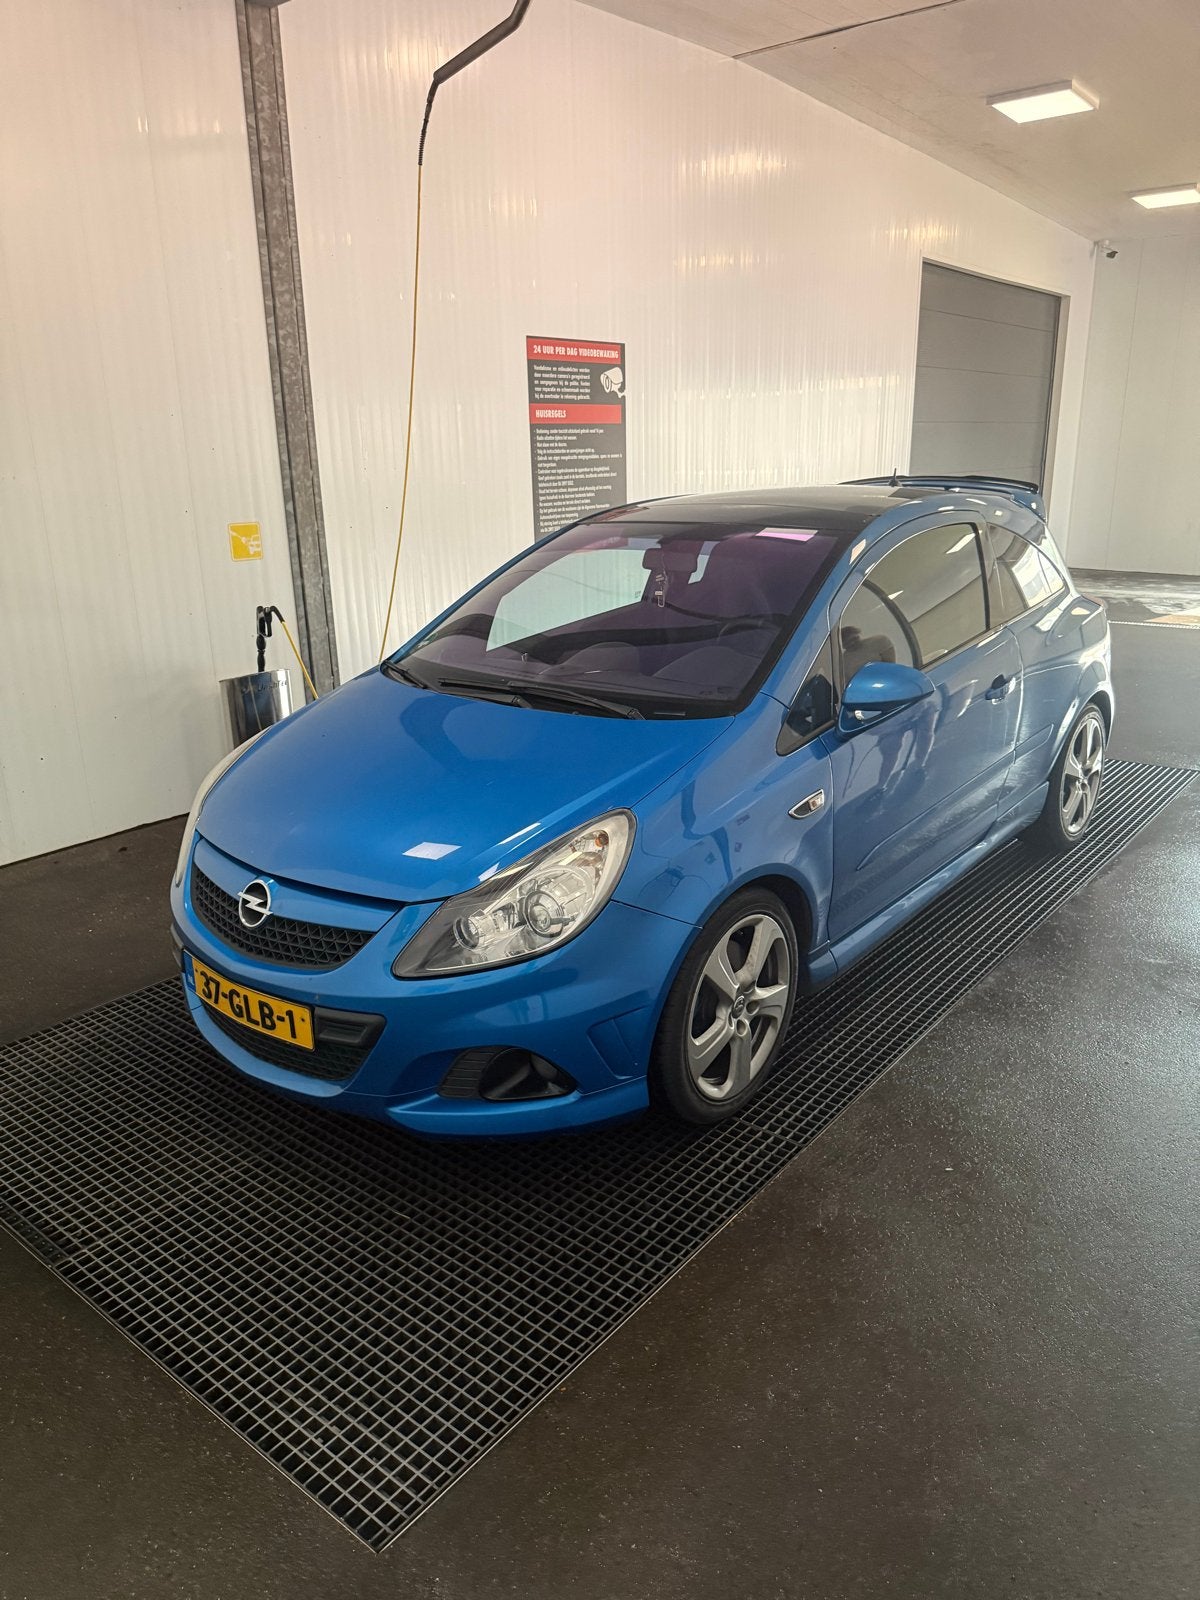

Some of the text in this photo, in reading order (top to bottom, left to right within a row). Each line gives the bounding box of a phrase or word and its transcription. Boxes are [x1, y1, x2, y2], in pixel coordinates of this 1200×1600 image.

[533, 345, 619, 359] 24 UUR PER DAG VIDEOBEWAKING
[535, 409, 567, 418] HUISREGELS
[199, 969, 298, 1039] 37-GLB-1
